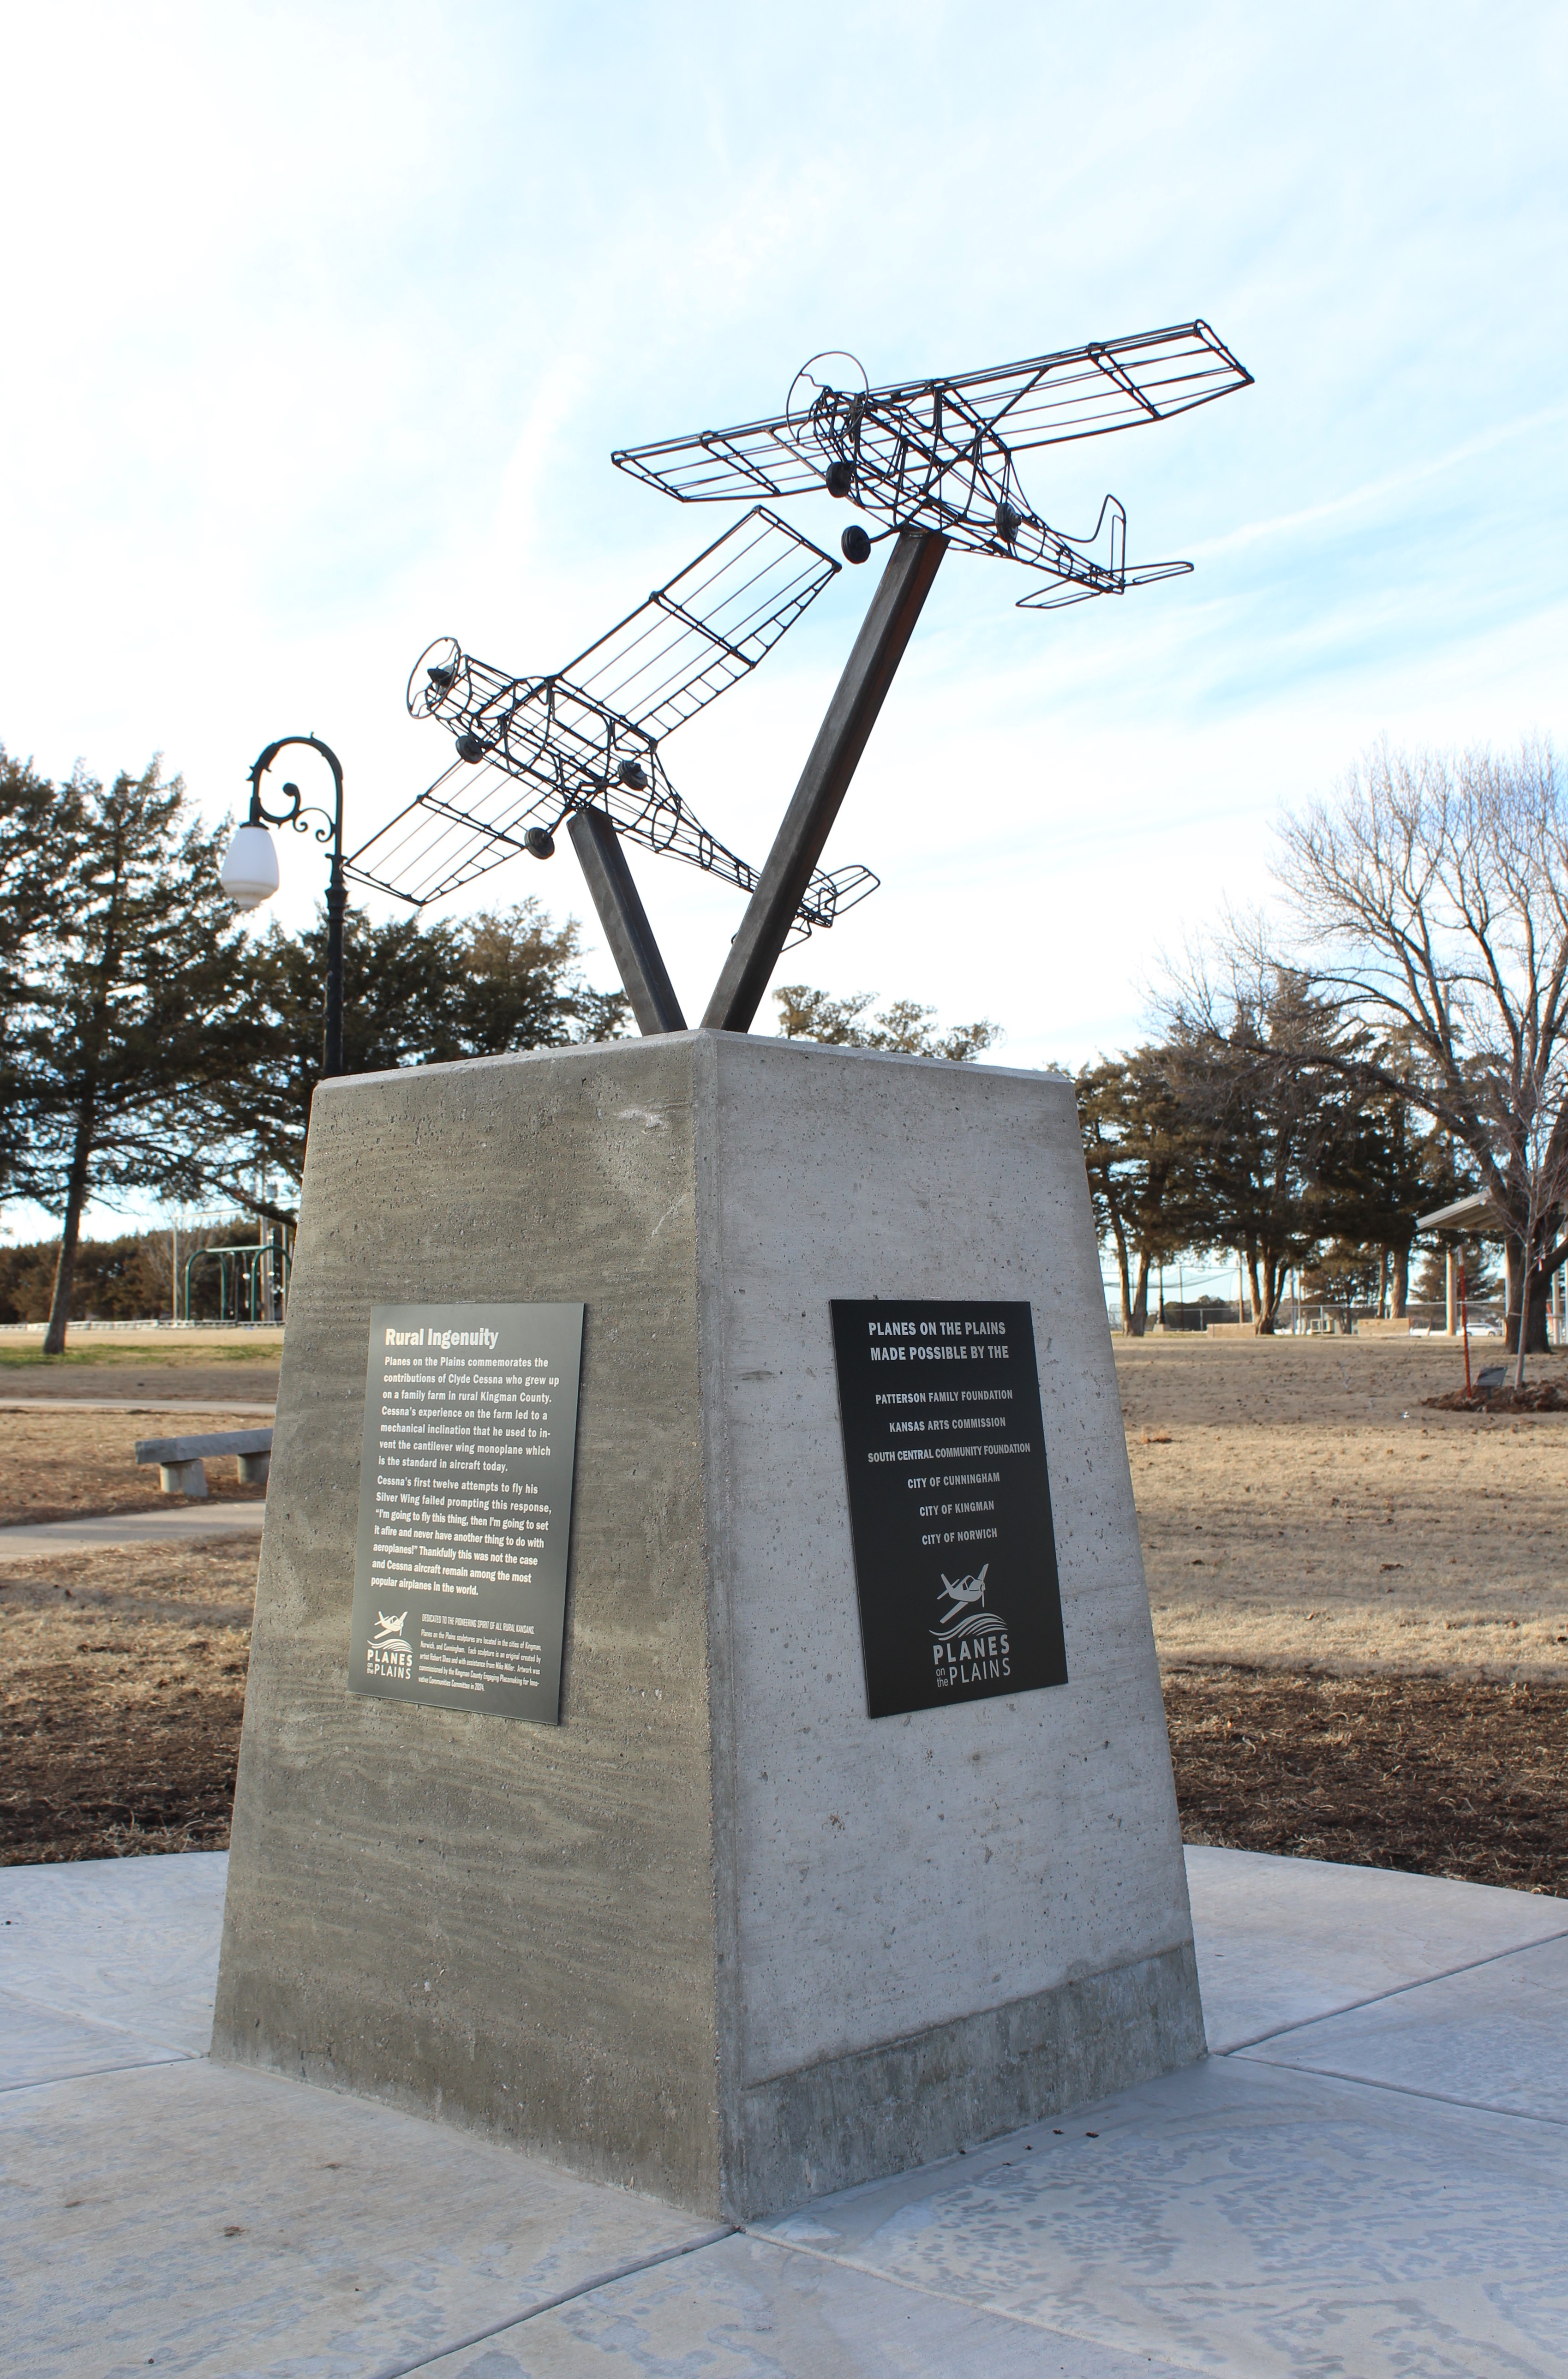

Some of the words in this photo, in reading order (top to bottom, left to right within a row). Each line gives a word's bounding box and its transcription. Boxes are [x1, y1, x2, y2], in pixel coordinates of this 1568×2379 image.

[868, 1322, 916, 1335] PLANES
[920, 1322, 936, 1335] ON
[940, 1322, 961, 1335] THE
[965, 1322, 1005, 1334] PLAINS
[385, 1328, 424, 1345] Rural
[428, 1327, 498, 1349] Ingenuity
[870, 1347, 906, 1360] MADE
[909, 1346, 967, 1360] POSSIBLE
[970, 1346, 984, 1358] BY
[987, 1345, 1008, 1358] THE
[385, 1356, 410, 1365] Planes
[425, 1356, 437, 1366] the
[440, 1357, 465, 1366] Plains
[468, 1358, 531, 1366] commemorates
[534, 1357, 548, 1366] the
[383, 1373, 435, 1383] contributions
[438, 1373, 446, 1383] of
[449, 1374, 470, 1385] Clyde
[473, 1374, 503, 1384] Cessna
[505, 1374, 522, 1384] who
[525, 1376, 546, 1386] grew
[549, 1377, 559, 1387] up
[401, 1390, 425, 1401] family
[428, 1390, 445, 1400] farm
[448, 1390, 455, 1400] in
[459, 1391, 478, 1400] rural
[480, 1391, 516, 1403] Kingman
[520, 1392, 551, 1404] County.
[875, 1393, 926, 1404] PATTERSON
[928, 1391, 958, 1402] FAMILY
[961, 1390, 1012, 1400] FOUNDATION
[419, 1407, 462, 1418] experience
[477, 1409, 490, 1418] the
[493, 1409, 512, 1419] farm
[515, 1409, 528, 1419] led
[531, 1410, 539, 1420] to
[380, 1423, 425, 1432] mechanical
[427, 1424, 470, 1434] inclination
[473, 1426, 490, 1435] that
[493, 1426, 503, 1436] he
[506, 1427, 525, 1437] used
[528, 1428, 536, 1437] to
[539, 1427, 550, 1438] in-
[889, 1421, 925, 1432] KANSAS
[928, 1420, 949, 1430] ARTS
[952, 1417, 1005, 1429] COMMISSION
[379, 1440, 395, 1448] vent
[398, 1440, 410, 1449] the
[413, 1441, 453, 1451] cantilever
[455, 1442, 475, 1454] wing
[477, 1444, 522, 1456] monoplane
[525, 1445, 550, 1456] which
[868, 1451, 895, 1462] SOUTH
[897, 1449, 934, 1460] CENTRAL
[935, 1446, 981, 1458] COMMUNITY
[984, 1443, 1030, 1455] FOUNDATION
[378, 1455, 385, 1465] is
[387, 1456, 400, 1465] the
[402, 1457, 437, 1467] standard
[439, 1458, 446, 1468] in
[449, 1459, 480, 1470] aircraft
[483, 1461, 507, 1473] today.
[414, 1477, 430, 1487] first
[433, 1479, 458, 1489] twelve
[461, 1480, 498, 1492] attempts
[501, 1483, 509, 1492] to
[512, 1482, 522, 1495] fly
[525, 1484, 538, 1493] his
[907, 1477, 926, 1488] CITY
[929, 1476, 940, 1486] OF
[943, 1472, 999, 1486] CUNNINGHAM
[376, 1492, 398, 1502] Silver
[400, 1493, 420, 1505] Wing
[422, 1494, 444, 1505] failed
[447, 1498, 489, 1510] prompting
[491, 1499, 507, 1509] this
[510, 1503, 551, 1514] response,
[919, 1505, 938, 1516] CITY
[941, 1504, 952, 1514] OF
[955, 1500, 994, 1513] KINGMAN
[391, 1510, 411, 1522] going
[413, 1511, 419, 1520] to
[422, 1511, 431, 1523] fly
[432, 1513, 445, 1522] this
[447, 1514, 468, 1526] thing,
[470, 1516, 487, 1526] then
[502, 1518, 525, 1530] going
[526, 1520, 534, 1529] to
[536, 1521, 549, 1530] set
[374, 1525, 379, 1534] it
[381, 1526, 397, 1535] afire
[398, 1528, 412, 1537] and
[413, 1530, 433, 1539] never
[435, 1530, 452, 1540] have
[454, 1533, 483, 1542] another
[484, 1534, 504, 1546] thing
[506, 1536, 514, 1545] to
[515, 1536, 525, 1546] do
[527, 1537, 544, 1548] with
[922, 1534, 940, 1545] CITY
[944, 1532, 954, 1542] OF
[957, 1528, 997, 1541] NORWICH
[419, 1546, 456, 1560] Thankfully
[458, 1549, 472, 1559] this
[473, 1552, 488, 1561] was
[490, 1553, 503, 1562] not
[505, 1553, 517, 1563] the
[519, 1557, 538, 1565] case
[372, 1559, 385, 1568] and
[387, 1560, 412, 1571] Cessna
[414, 1563, 441, 1574] aircraft
[442, 1566, 467, 1576] remain
[470, 1570, 496, 1581] among
[497, 1570, 510, 1580] the
[512, 1573, 531, 1582] most
[371, 1577, 397, 1587] popular
[399, 1578, 431, 1590] airplanes
[433, 1581, 440, 1591] in
[442, 1582, 454, 1593] the
[456, 1585, 478, 1595] world.
[422, 1613, 441, 1623] DEDICATED
[455, 1617, 476, 1627] PIONEERING
[477, 1620, 489, 1628] SPIRIT
[503, 1623, 515, 1632] RURAL
[516, 1624, 534, 1634] KANSANS.
[367, 1649, 412, 1666] PLANES
[933, 1634, 1009, 1665] PLANES
[374, 1664, 410, 1679] PLAINS
[936, 1668, 945, 1676] on
[949, 1657, 1010, 1685] PLAINS
[937, 1677, 948, 1687] the
